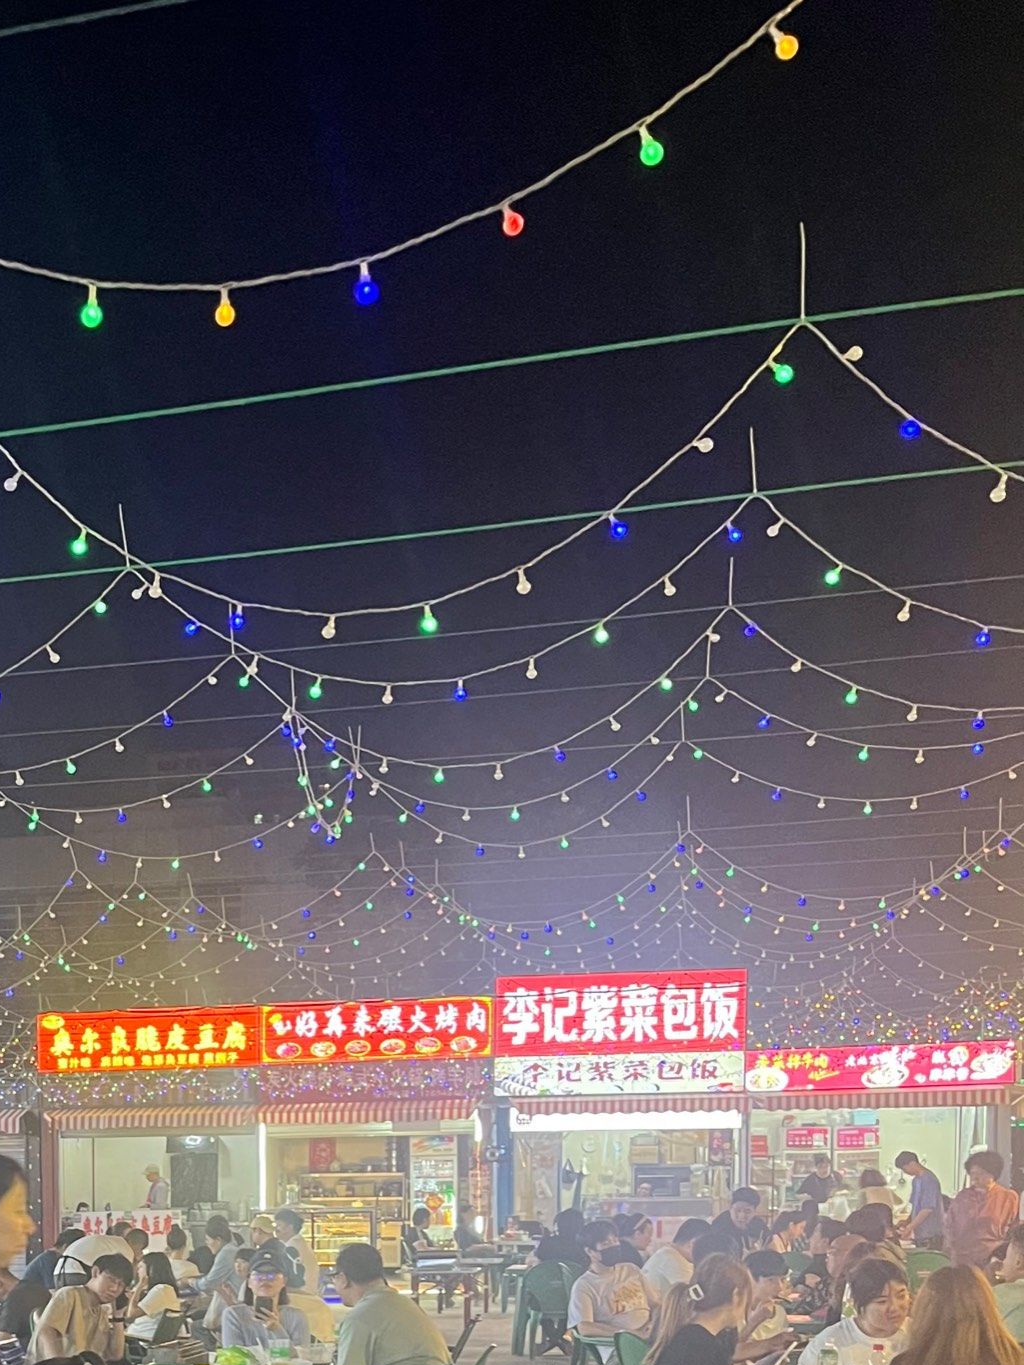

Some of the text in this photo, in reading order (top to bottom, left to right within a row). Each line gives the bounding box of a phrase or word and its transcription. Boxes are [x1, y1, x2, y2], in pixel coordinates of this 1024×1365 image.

[502, 982, 740, 1045] 李记紫菜包饭
[523, 1059, 719, 1083] 李记紫菜包饭
